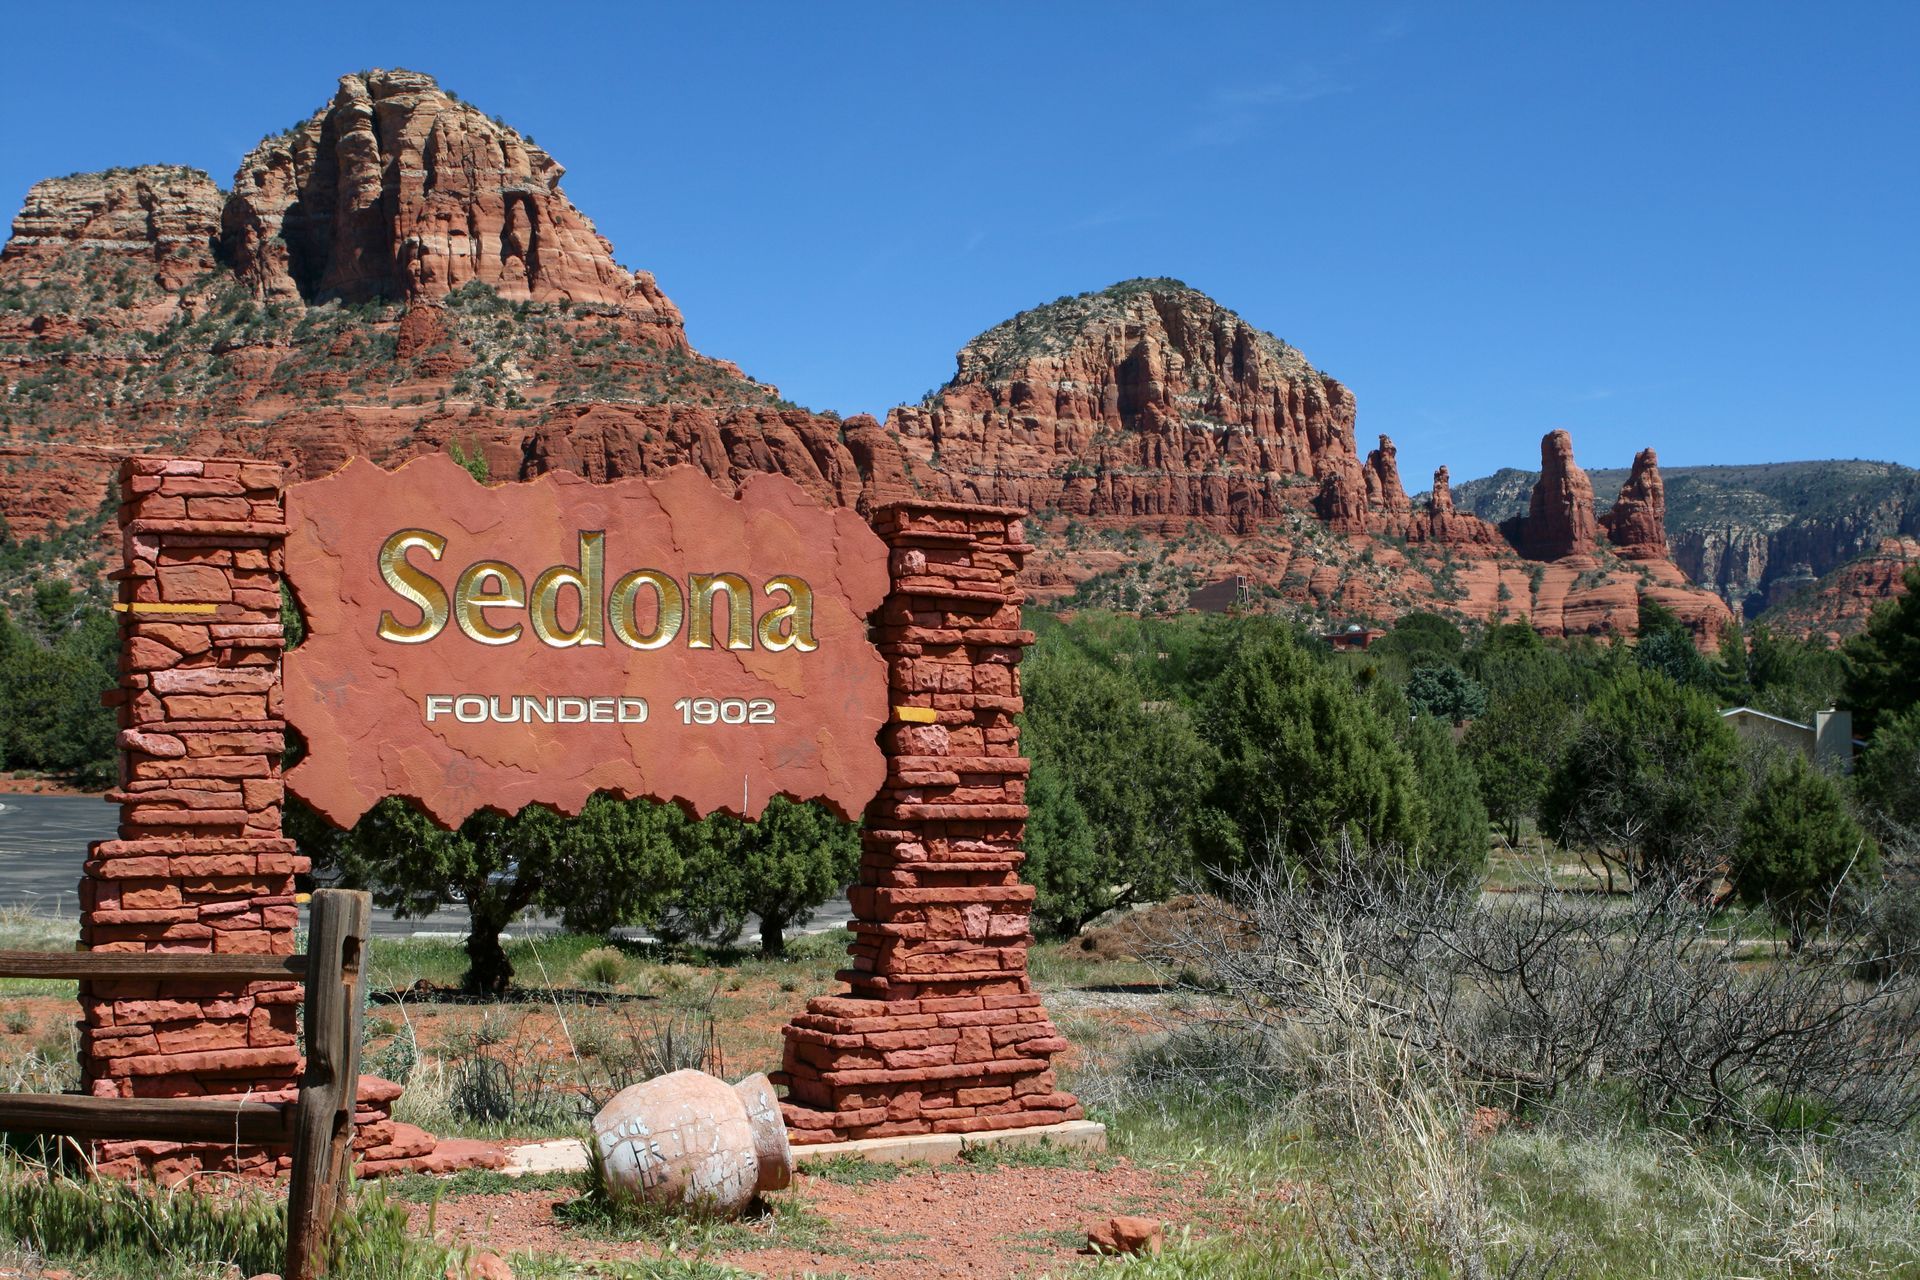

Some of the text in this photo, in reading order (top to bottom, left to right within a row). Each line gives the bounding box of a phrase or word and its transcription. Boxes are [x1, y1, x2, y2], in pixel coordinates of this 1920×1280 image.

[377, 529, 819, 652] Sedona
[426, 695, 777, 725] FOUNDED 1902
